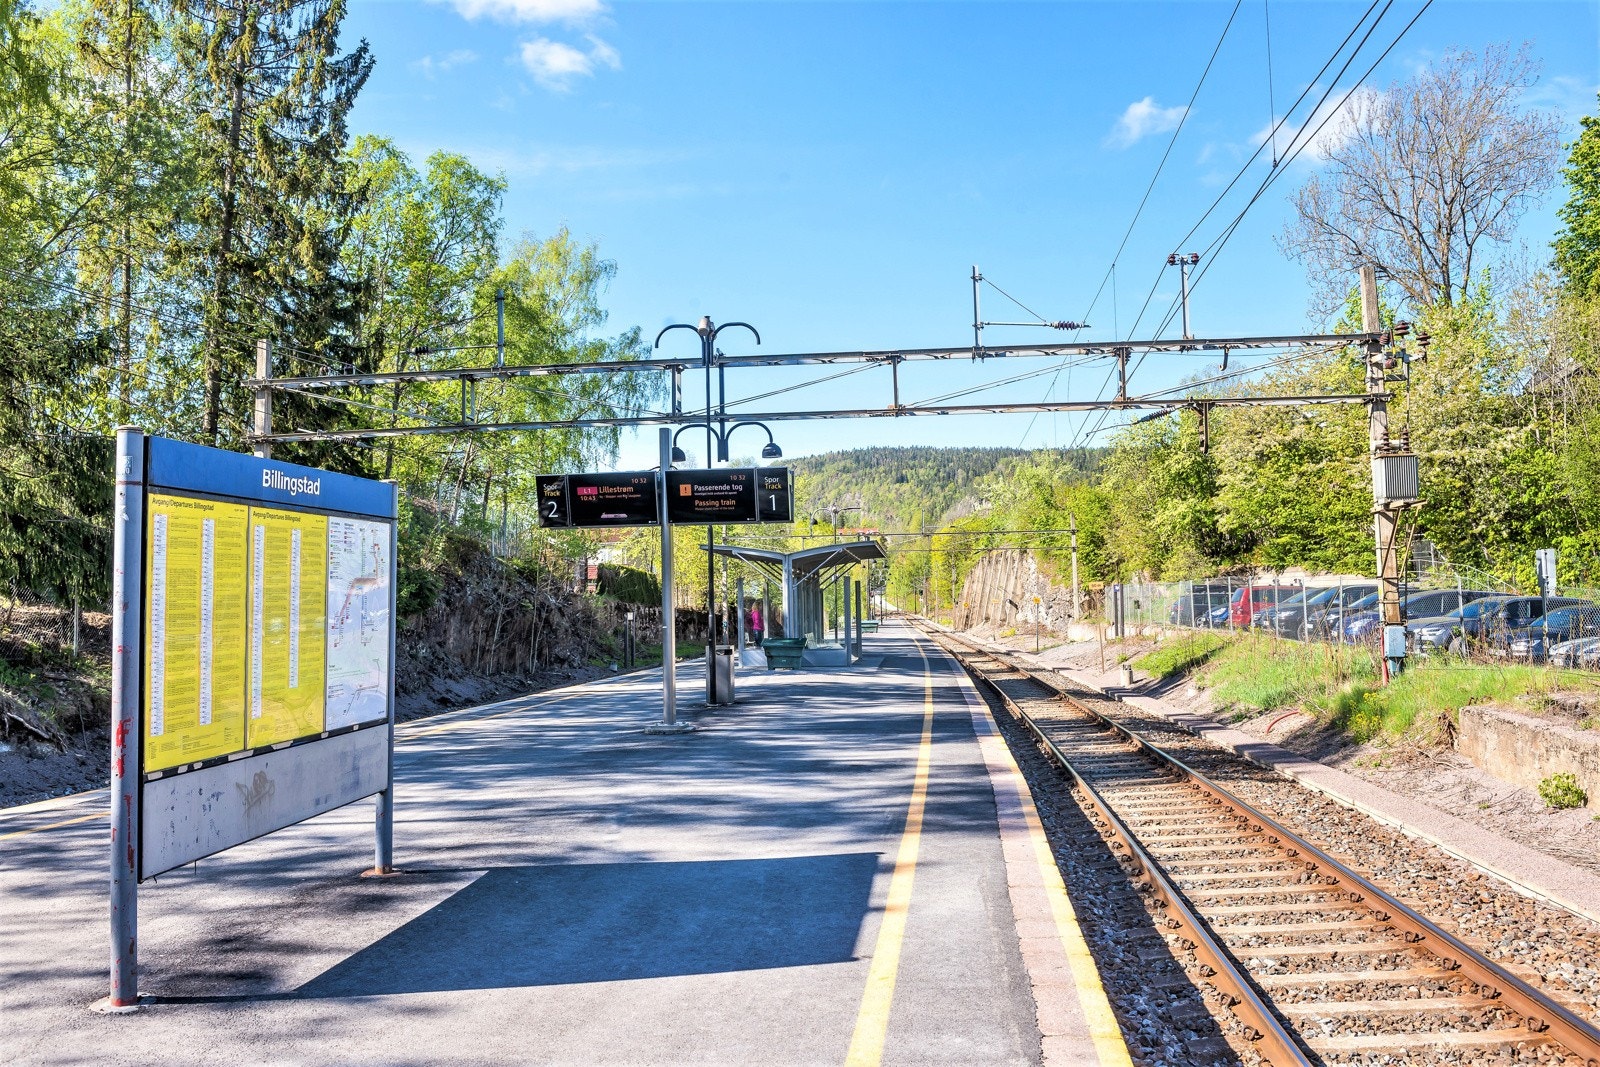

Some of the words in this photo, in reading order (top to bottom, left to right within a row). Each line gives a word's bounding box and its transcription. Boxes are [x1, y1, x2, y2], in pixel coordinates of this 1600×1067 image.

[262, 469, 320, 496] Billingstad
[547, 501, 559, 518] 2
[695, 499, 719, 507] Passing
[769, 494, 776, 511] 1
